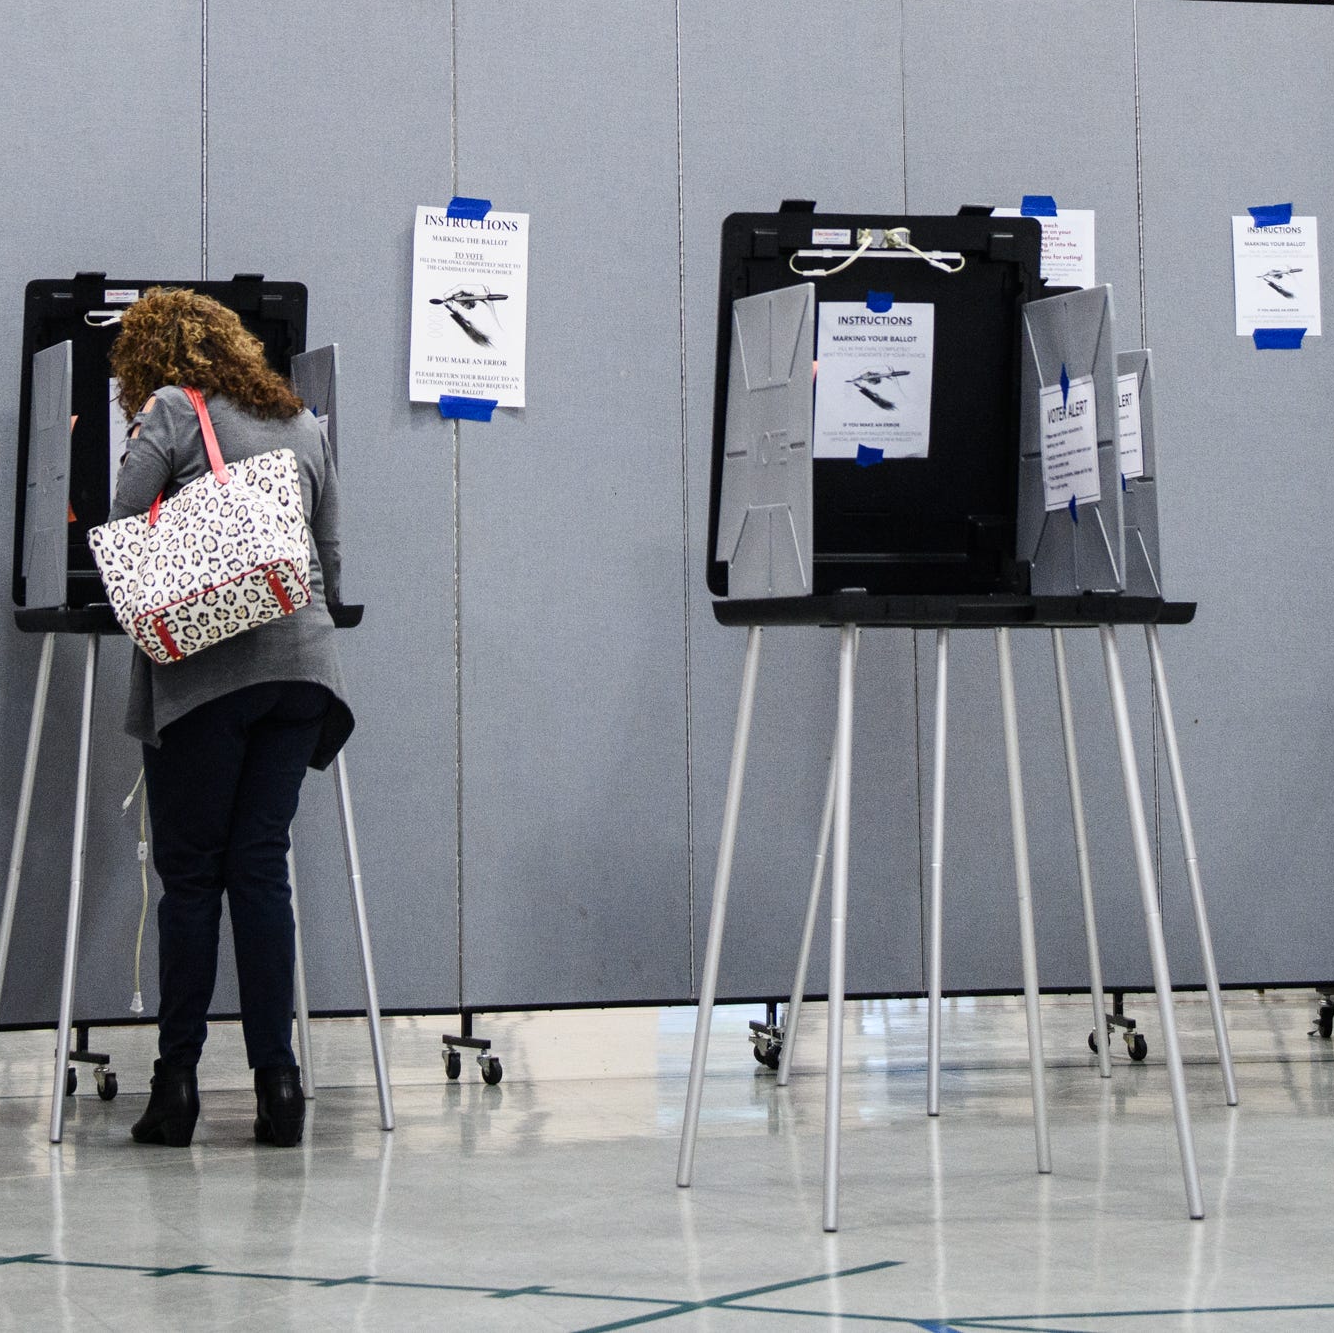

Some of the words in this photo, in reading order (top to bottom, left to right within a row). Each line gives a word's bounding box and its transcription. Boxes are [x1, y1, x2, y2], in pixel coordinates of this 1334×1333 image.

[425, 215, 518, 232] INSTRUCTIONS
[1247, 226, 1302, 234] INSTRUCTIONS
[432, 235, 465, 243] MARKING
[466, 237, 480, 245] THE
[481, 238, 508, 246] BALLOT
[838, 316, 913, 326] INSTRUCTIONS
[1119, 392, 1133, 408] LERT
[1068, 398, 1088, 418] ALERT
